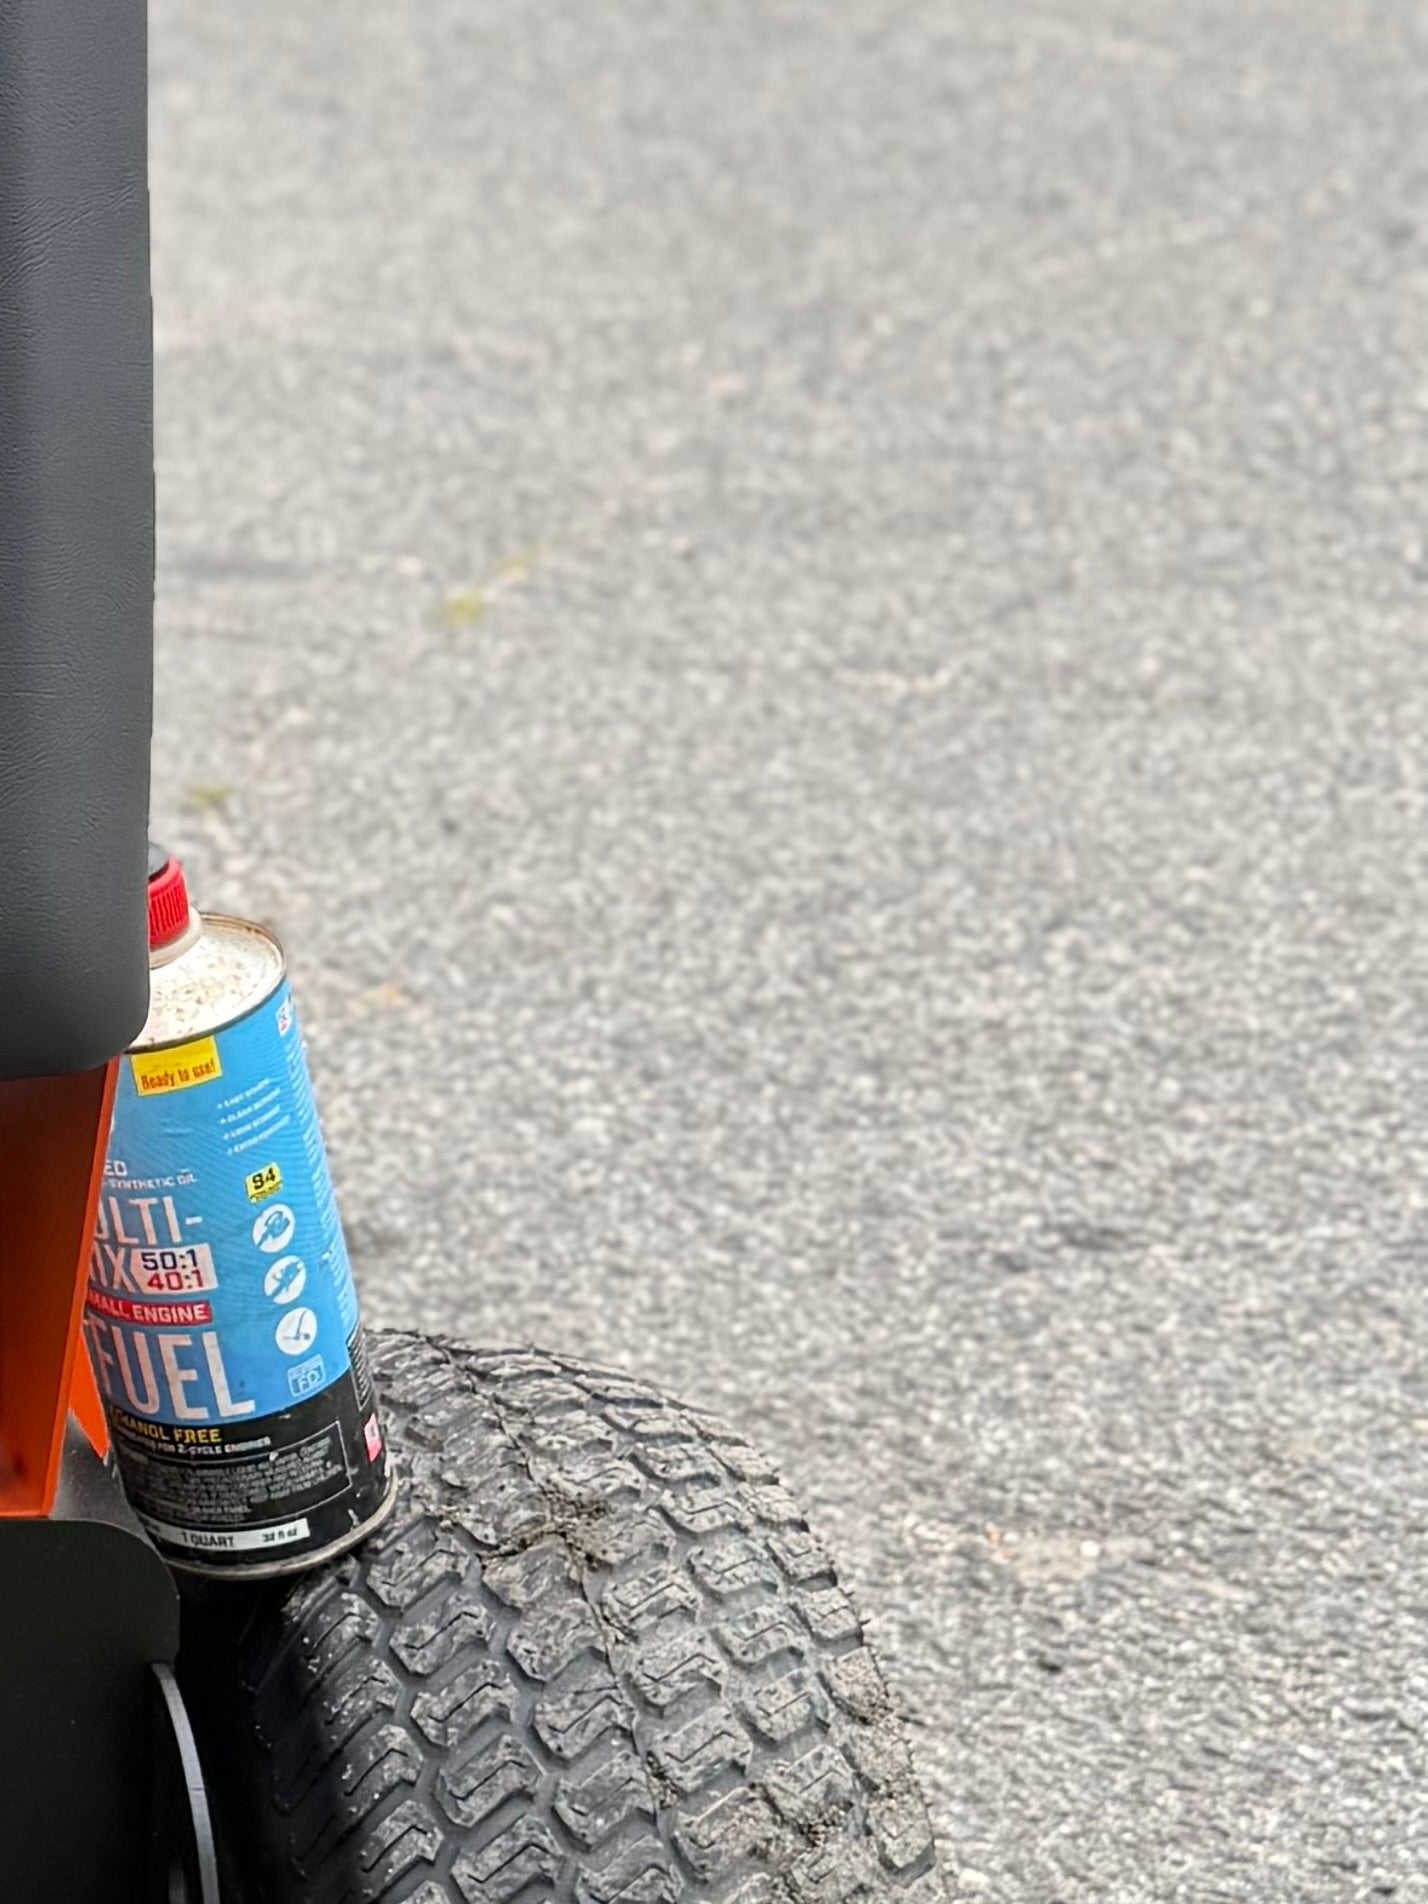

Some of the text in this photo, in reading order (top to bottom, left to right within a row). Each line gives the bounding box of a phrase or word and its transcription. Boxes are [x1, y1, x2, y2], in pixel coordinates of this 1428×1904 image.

[140, 1071, 176, 1091] Ready
[142, 1248, 199, 1271] 50:1
[147, 1270, 204, 1291] 40:1
[132, 1304, 208, 1324] ENGINE
[87, 1311, 256, 1420] FUEL
[174, 1427, 222, 1444] FREE
[190, 1534, 235, 1548] QUART
